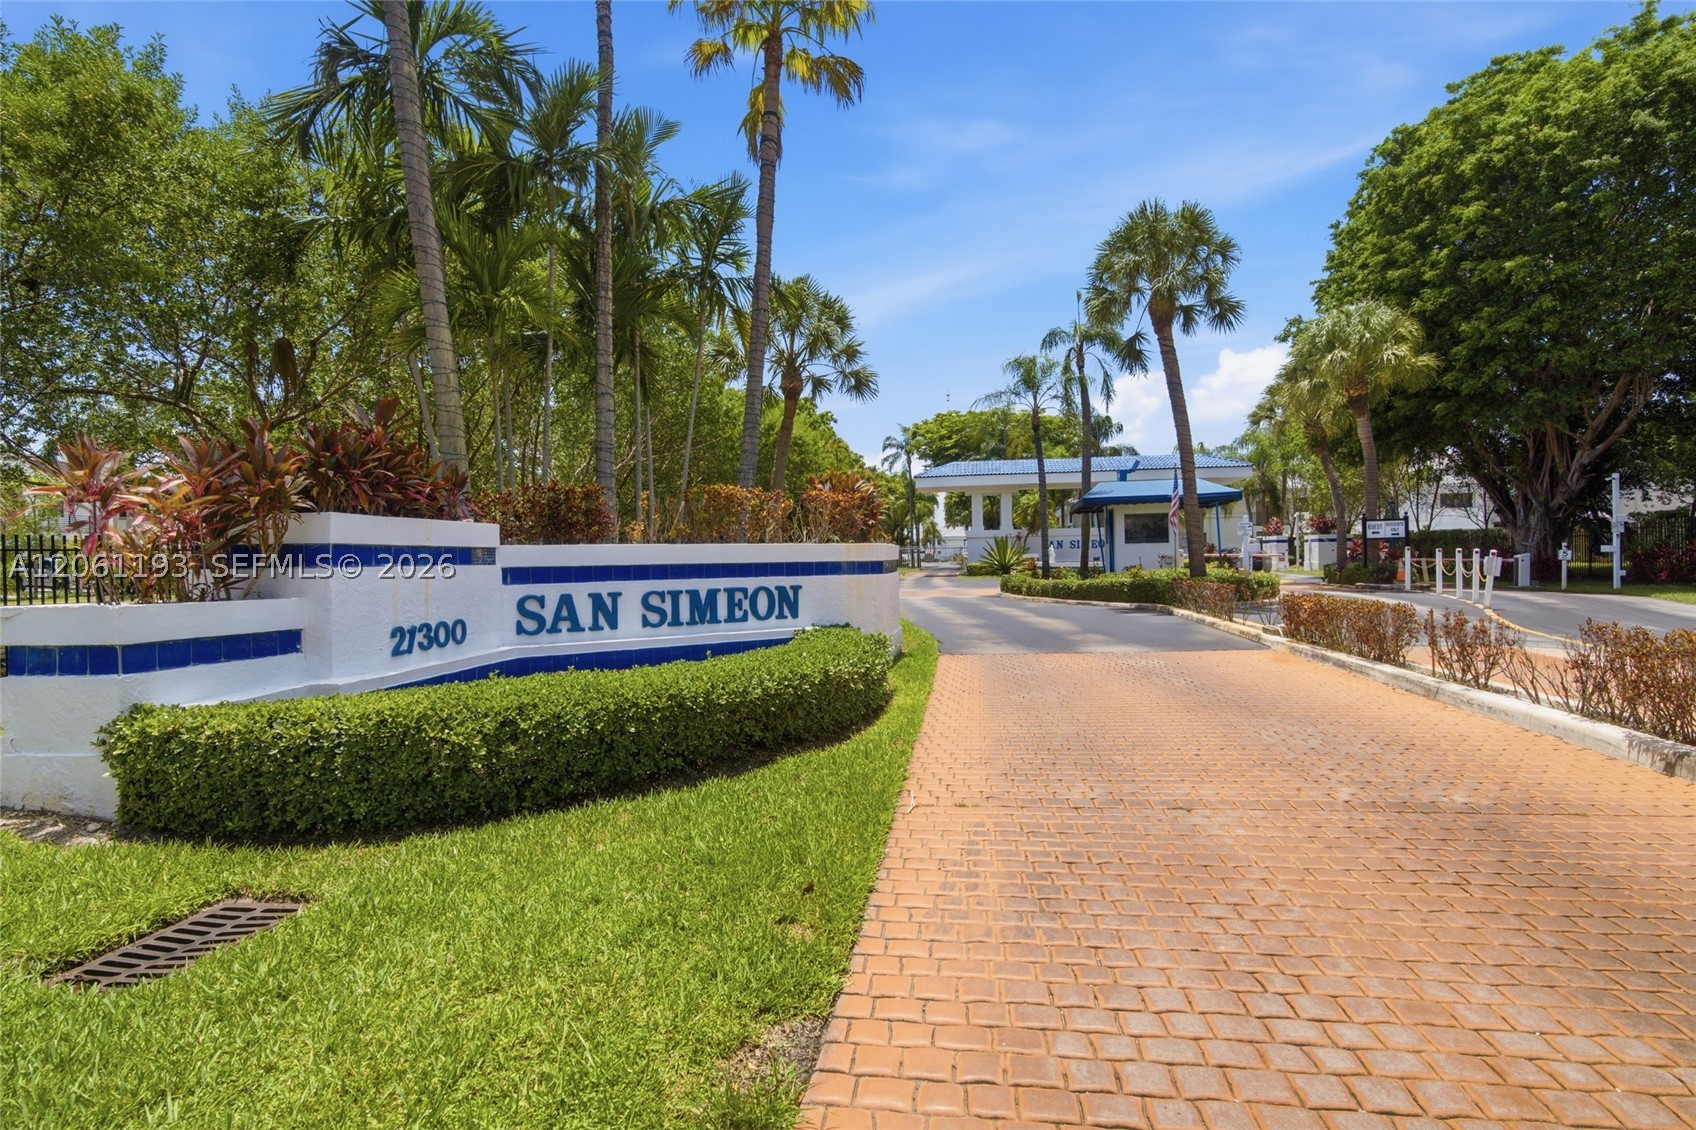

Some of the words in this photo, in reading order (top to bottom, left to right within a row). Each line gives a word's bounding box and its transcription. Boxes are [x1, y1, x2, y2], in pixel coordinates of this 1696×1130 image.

[516, 591, 622, 635] SAN
[641, 585, 802, 628] SIMEON
[390, 618, 467, 657] 21300
